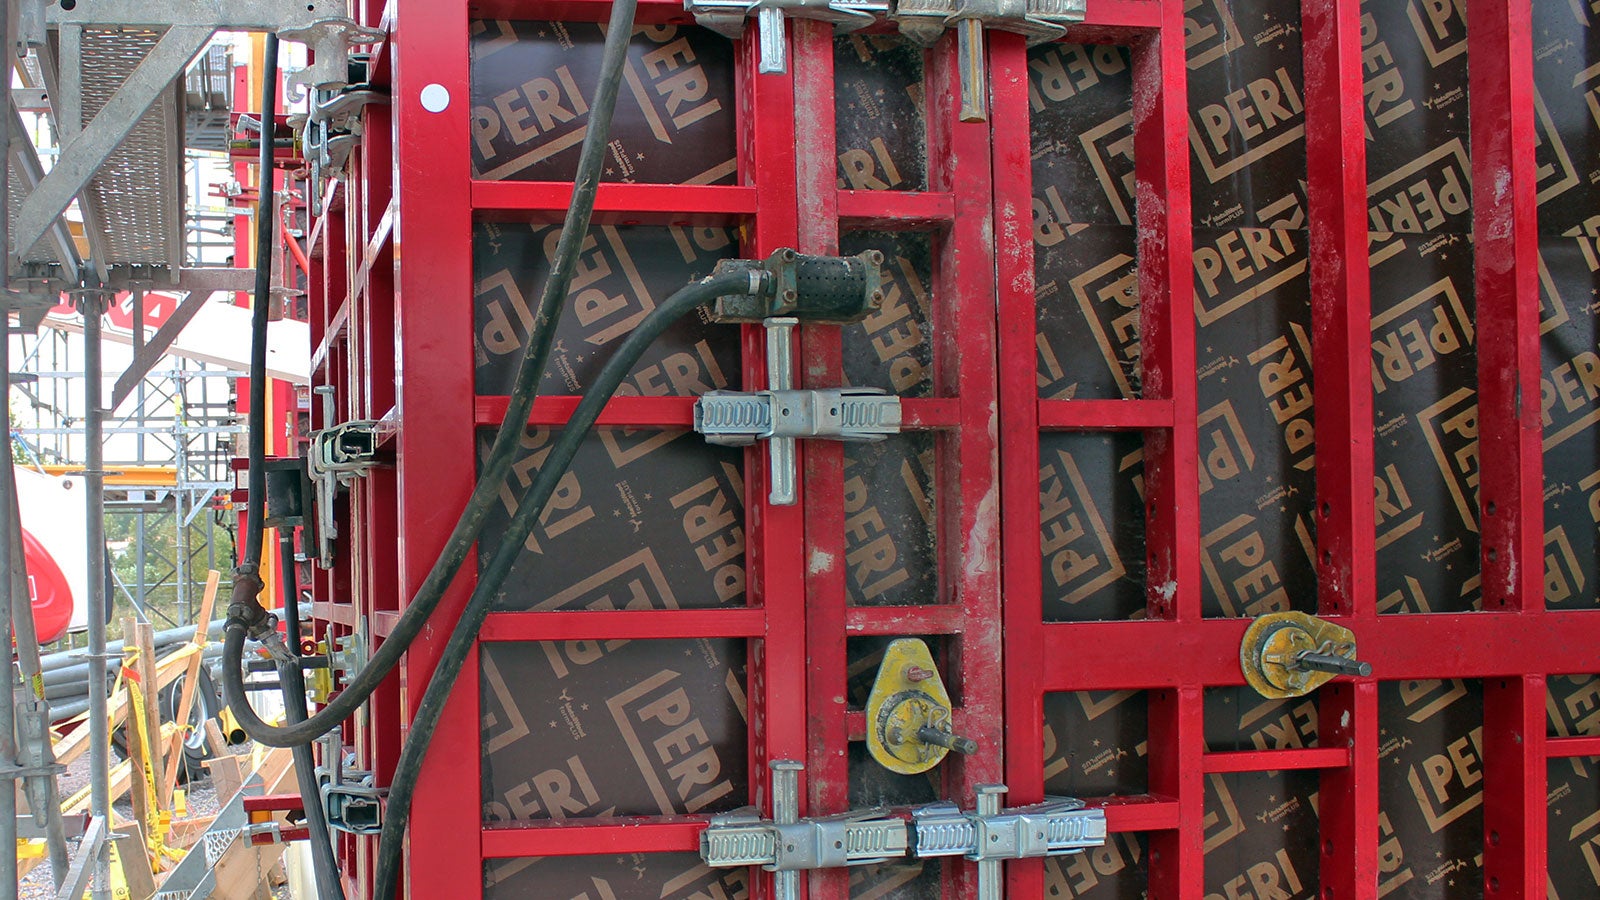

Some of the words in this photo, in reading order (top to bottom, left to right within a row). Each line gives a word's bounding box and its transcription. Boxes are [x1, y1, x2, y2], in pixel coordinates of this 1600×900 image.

[1198, 67, 1304, 155] PERI
[1360, 12, 1415, 128] PERI
[470, 65, 589, 160] PERI
[837, 137, 902, 190] RI
[1368, 165, 1470, 233] PERI
[1193, 228, 1295, 298] PERI
[615, 339, 727, 396] ERI
[862, 269, 931, 393] PER
[1371, 305, 1461, 394] PERI
[553, 357, 576, 392] formPLUS
[1247, 335, 1315, 454] PERI
[1541, 345, 1600, 427] PER
[620, 479, 642, 514] formPLUS
[1374, 463, 1412, 526] RI
[1441, 404, 1480, 508] PE
[669, 476, 745, 602] PERI
[844, 476, 910, 600] PERI
[1219, 530, 1291, 615] PER
[558, 705, 581, 740] formPLUS
[637, 687, 733, 813] PERI
[1422, 726, 1484, 804] PE
[1044, 833, 1125, 900] PER
[1204, 848, 1303, 900] ERI
[1378, 811, 1414, 899] RI
